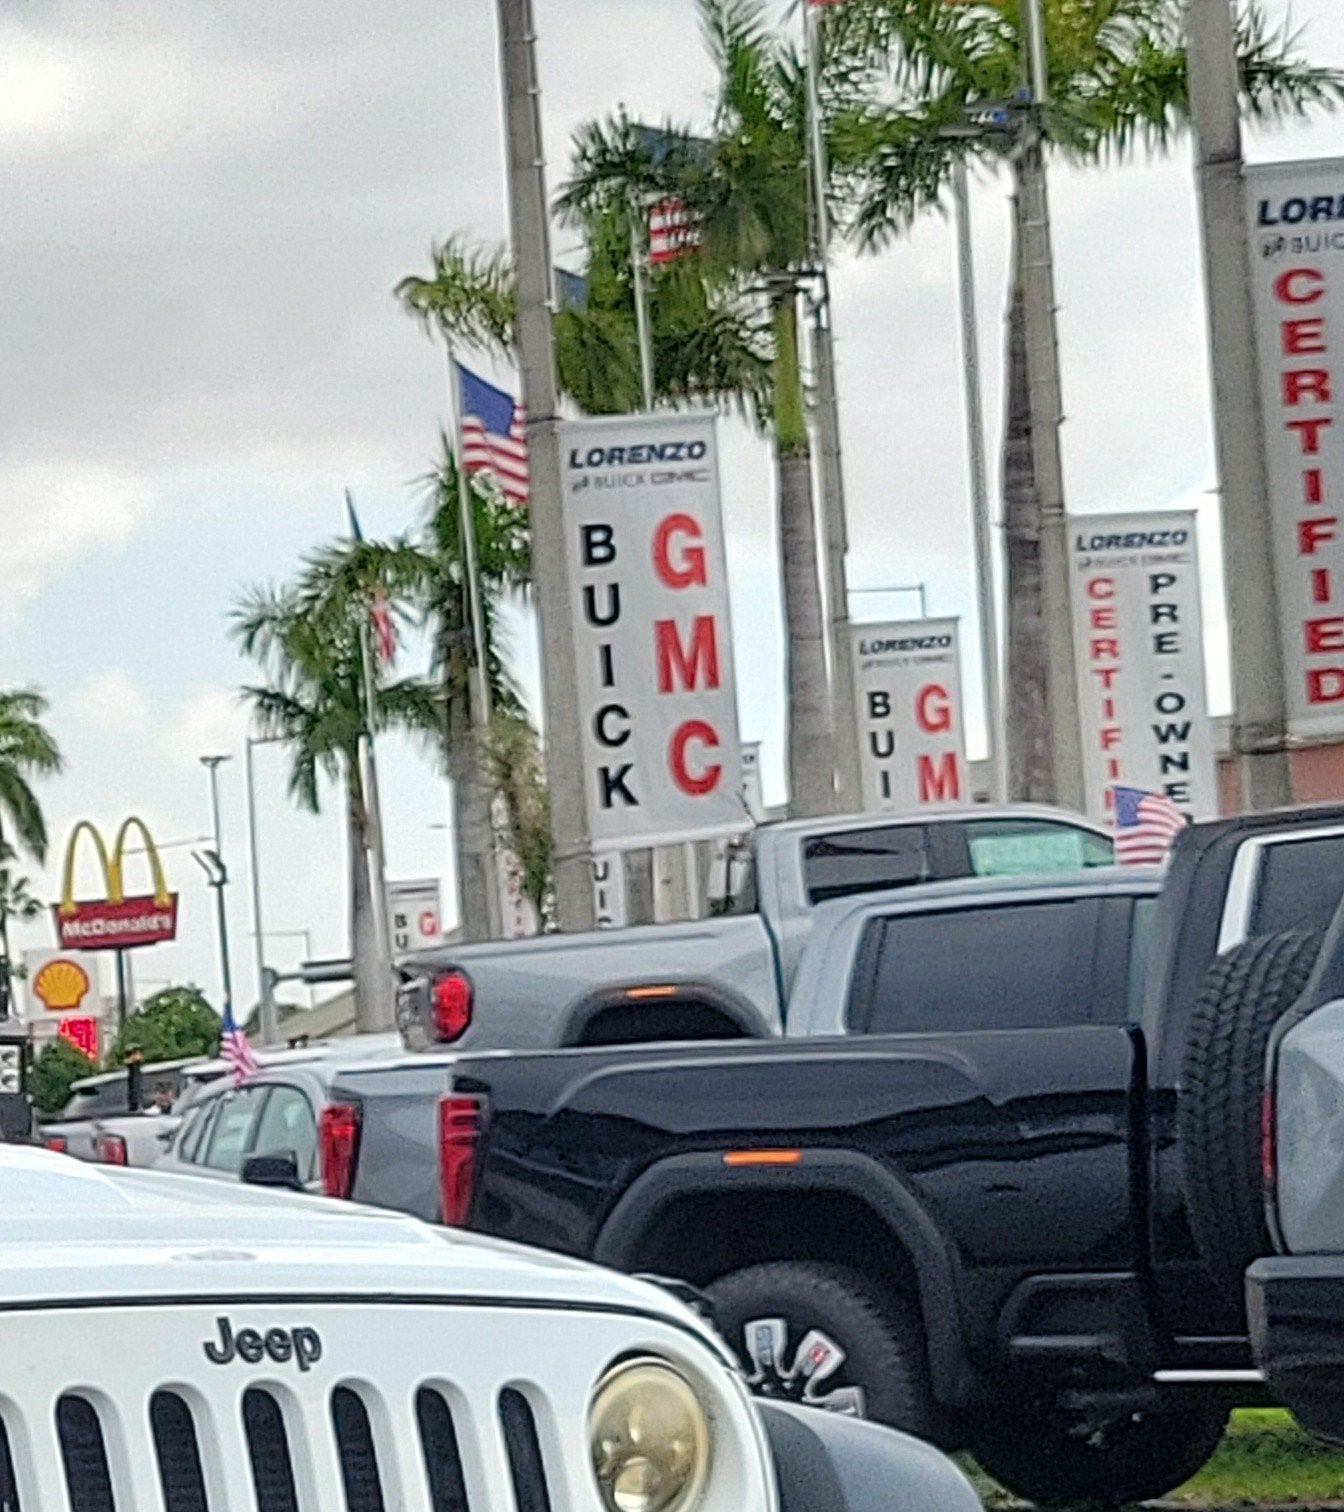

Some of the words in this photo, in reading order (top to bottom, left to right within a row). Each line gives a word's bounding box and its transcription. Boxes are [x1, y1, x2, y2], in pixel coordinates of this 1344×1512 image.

[569, 439, 708, 470] LORENZO
[1075, 529, 1188, 551] LORENZO
[579, 522, 639, 809] BUICK
[651, 512, 723, 798] GMC
[858, 633, 952, 656] LORENZO
[866, 691, 896, 808] BUI
[62, 913, 172, 938] McDonald's
[202, 1316, 323, 1373] Jeep
